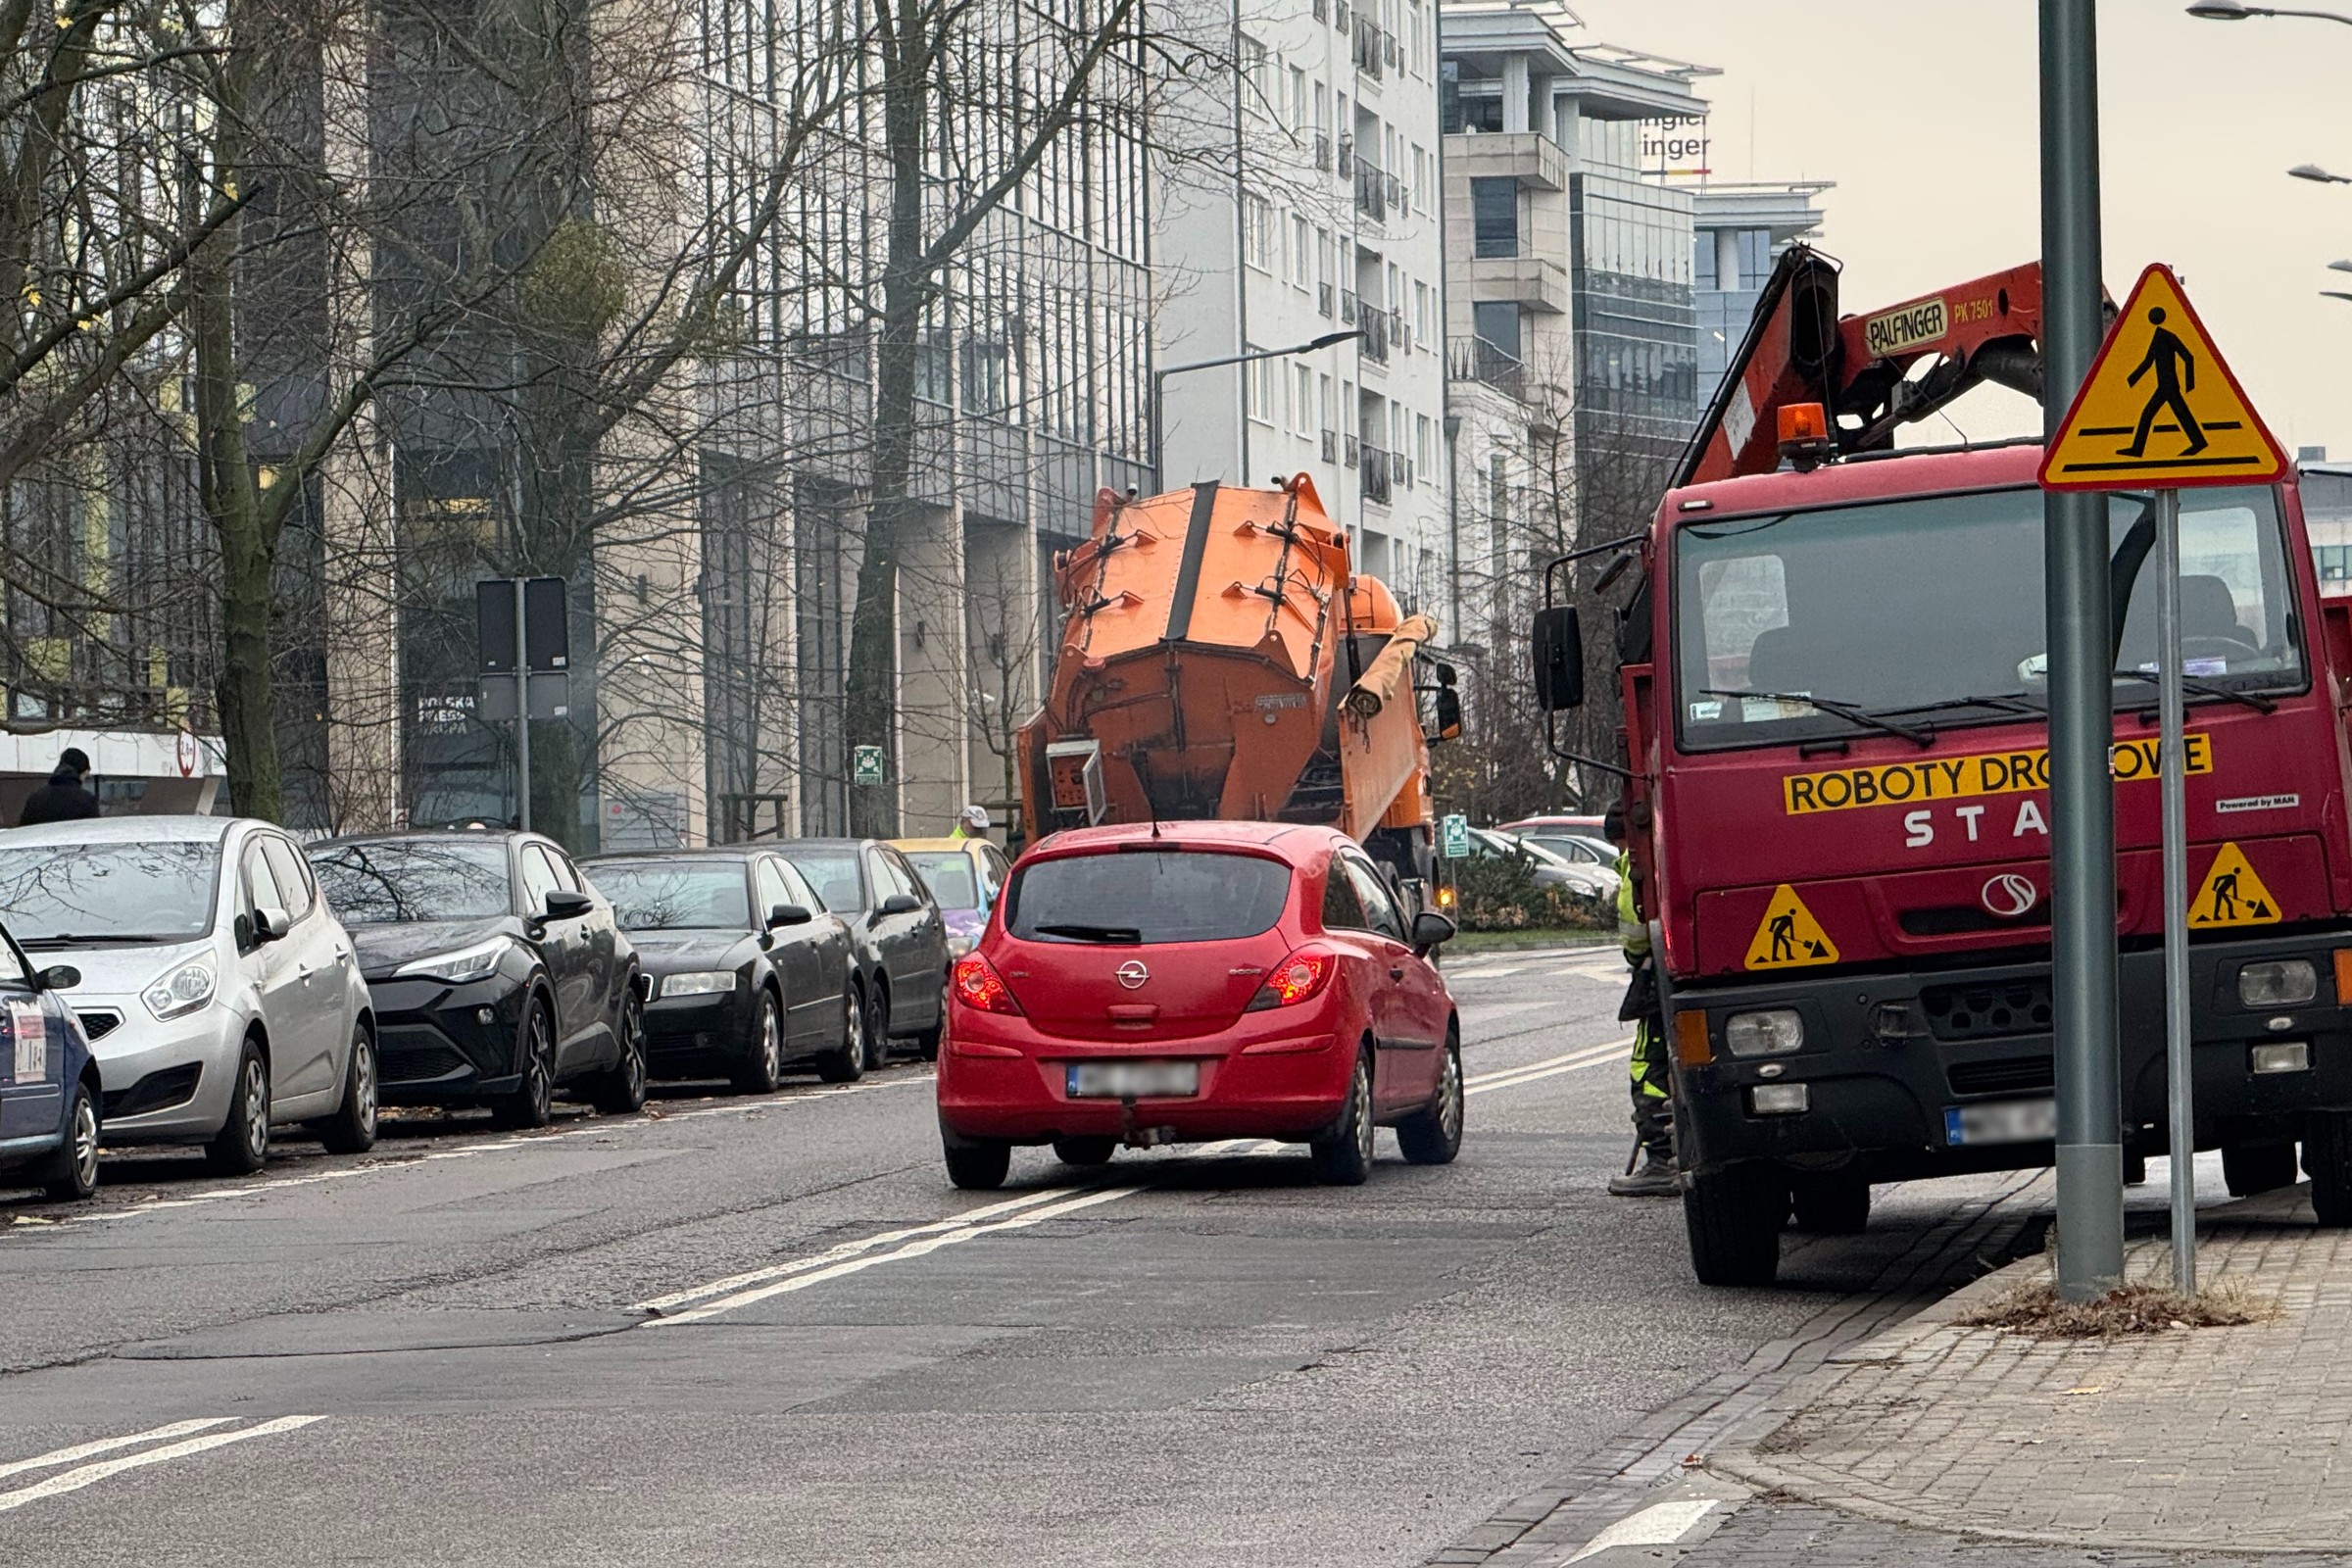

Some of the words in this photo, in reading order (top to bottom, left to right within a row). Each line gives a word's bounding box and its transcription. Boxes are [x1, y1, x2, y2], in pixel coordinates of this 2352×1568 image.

[1643, 133, 1711, 160] inger
[1954, 304, 1969, 323] PK
[1971, 299, 1994, 321] 7501
[1870, 304, 1943, 351] PALFINGER
[1790, 760, 1965, 810] ROBOTY
[1980, 737, 2205, 791] DROE
[2220, 800, 2258, 809] Powered
